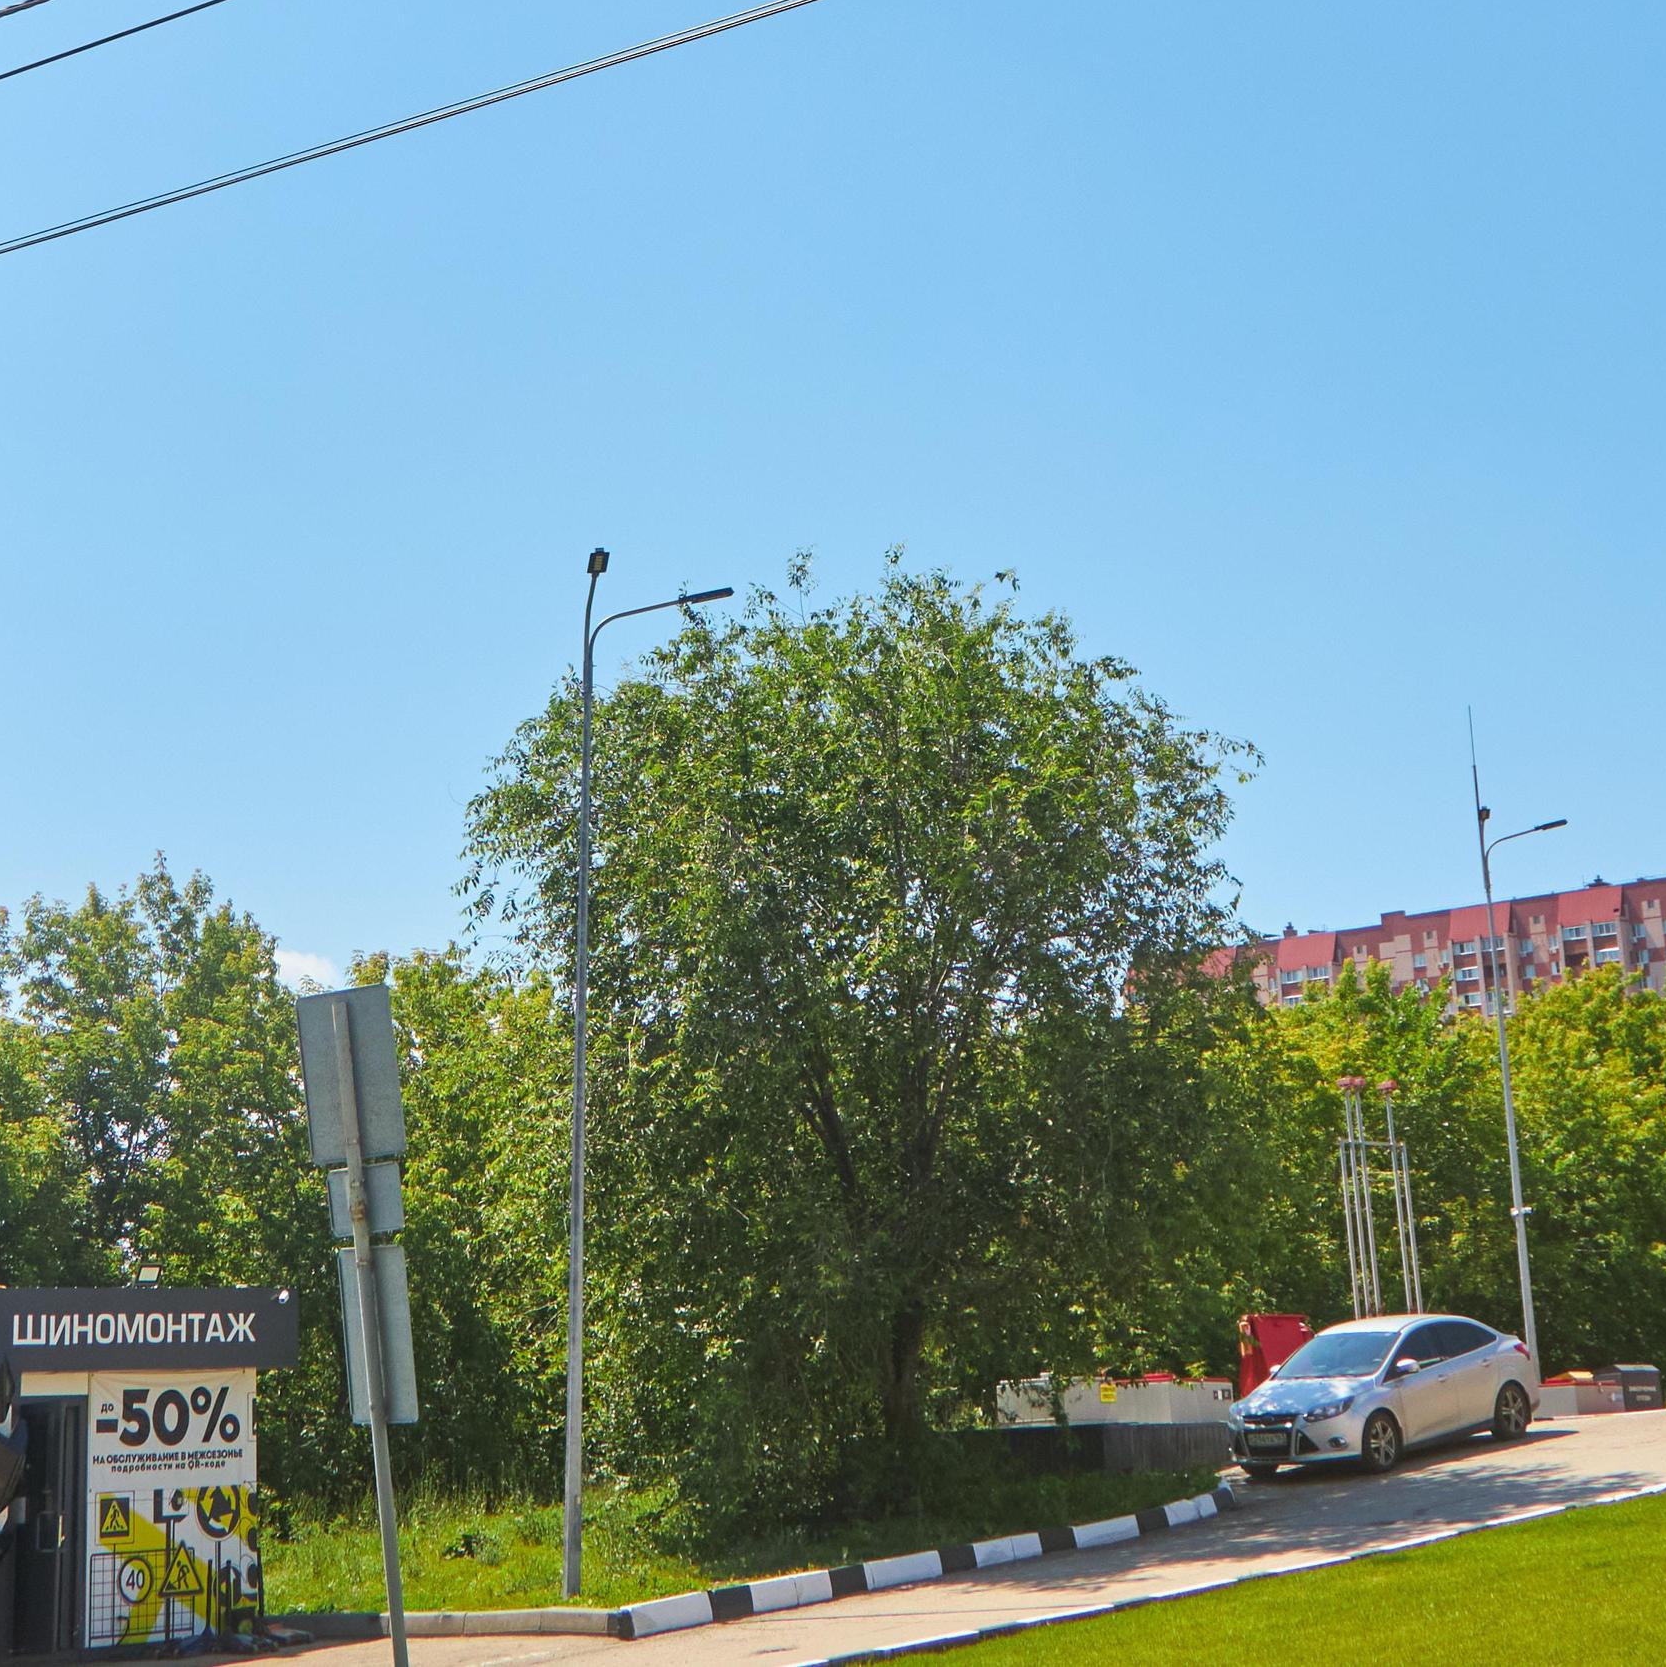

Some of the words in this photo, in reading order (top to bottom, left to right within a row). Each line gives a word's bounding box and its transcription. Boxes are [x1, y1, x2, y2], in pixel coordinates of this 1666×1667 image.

[12, 1311, 257, 1348] ШИНОМОНТАЖ
[96, 1386, 241, 1447] -50%
[93, 1454, 106, 1466] НА
[106, 1451, 180, 1464] ОБСЛУЖИВАНИЕ
[180, 1451, 187, 1462] В
[187, 1448, 244, 1461] МЕЖСЕЗОНЬЕ
[111, 1463, 173, 1475] подробности
[175, 1462, 186, 1470] на
[187, 1460, 226, 1471] QR-коде
[125, 1569, 146, 1591] 40
